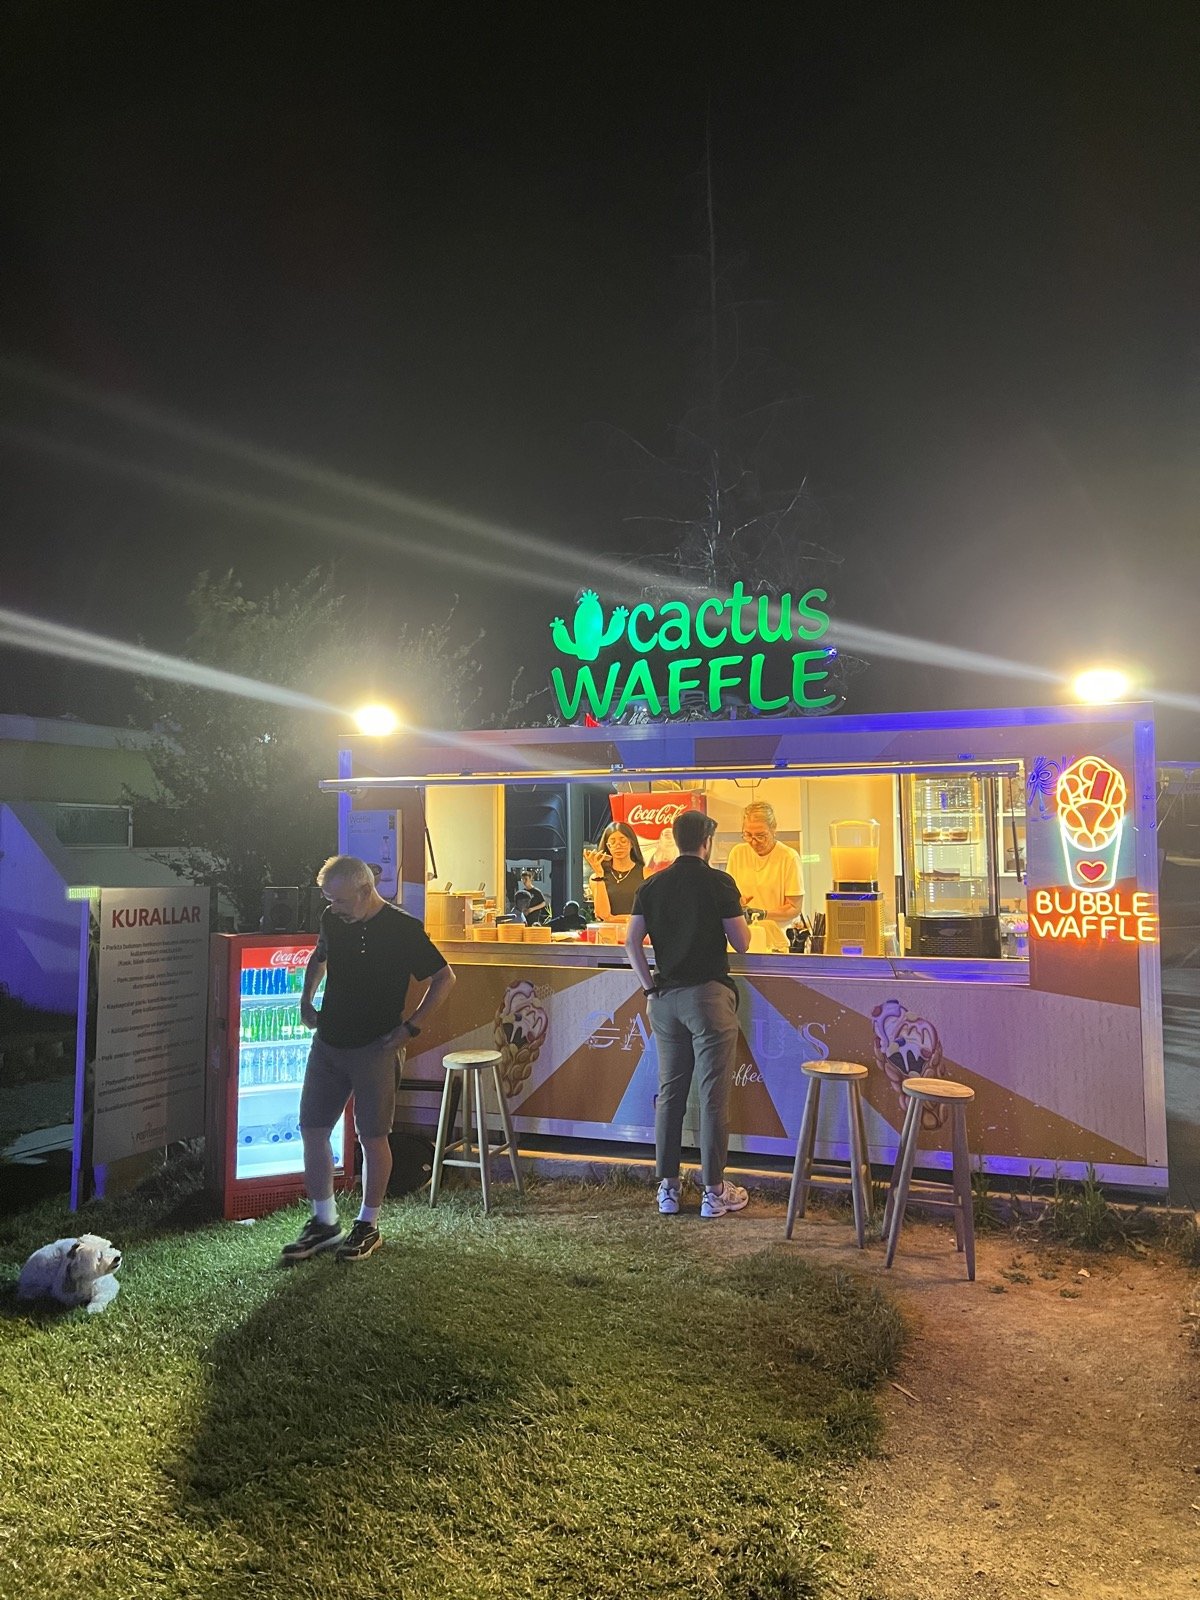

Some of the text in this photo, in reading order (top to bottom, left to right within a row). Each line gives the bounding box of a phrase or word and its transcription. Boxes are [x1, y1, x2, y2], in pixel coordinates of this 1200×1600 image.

[627, 580, 832, 653] cactus
[551, 650, 837, 720] WAFFLE
[628, 804, 688, 826] Coca-Col
[1034, 890, 1153, 916] BUBBLE
[112, 906, 201, 928] KURALLAR
[1030, 914, 1158, 941] WAFFLE
[270, 949, 314, 966] Coca-Col
